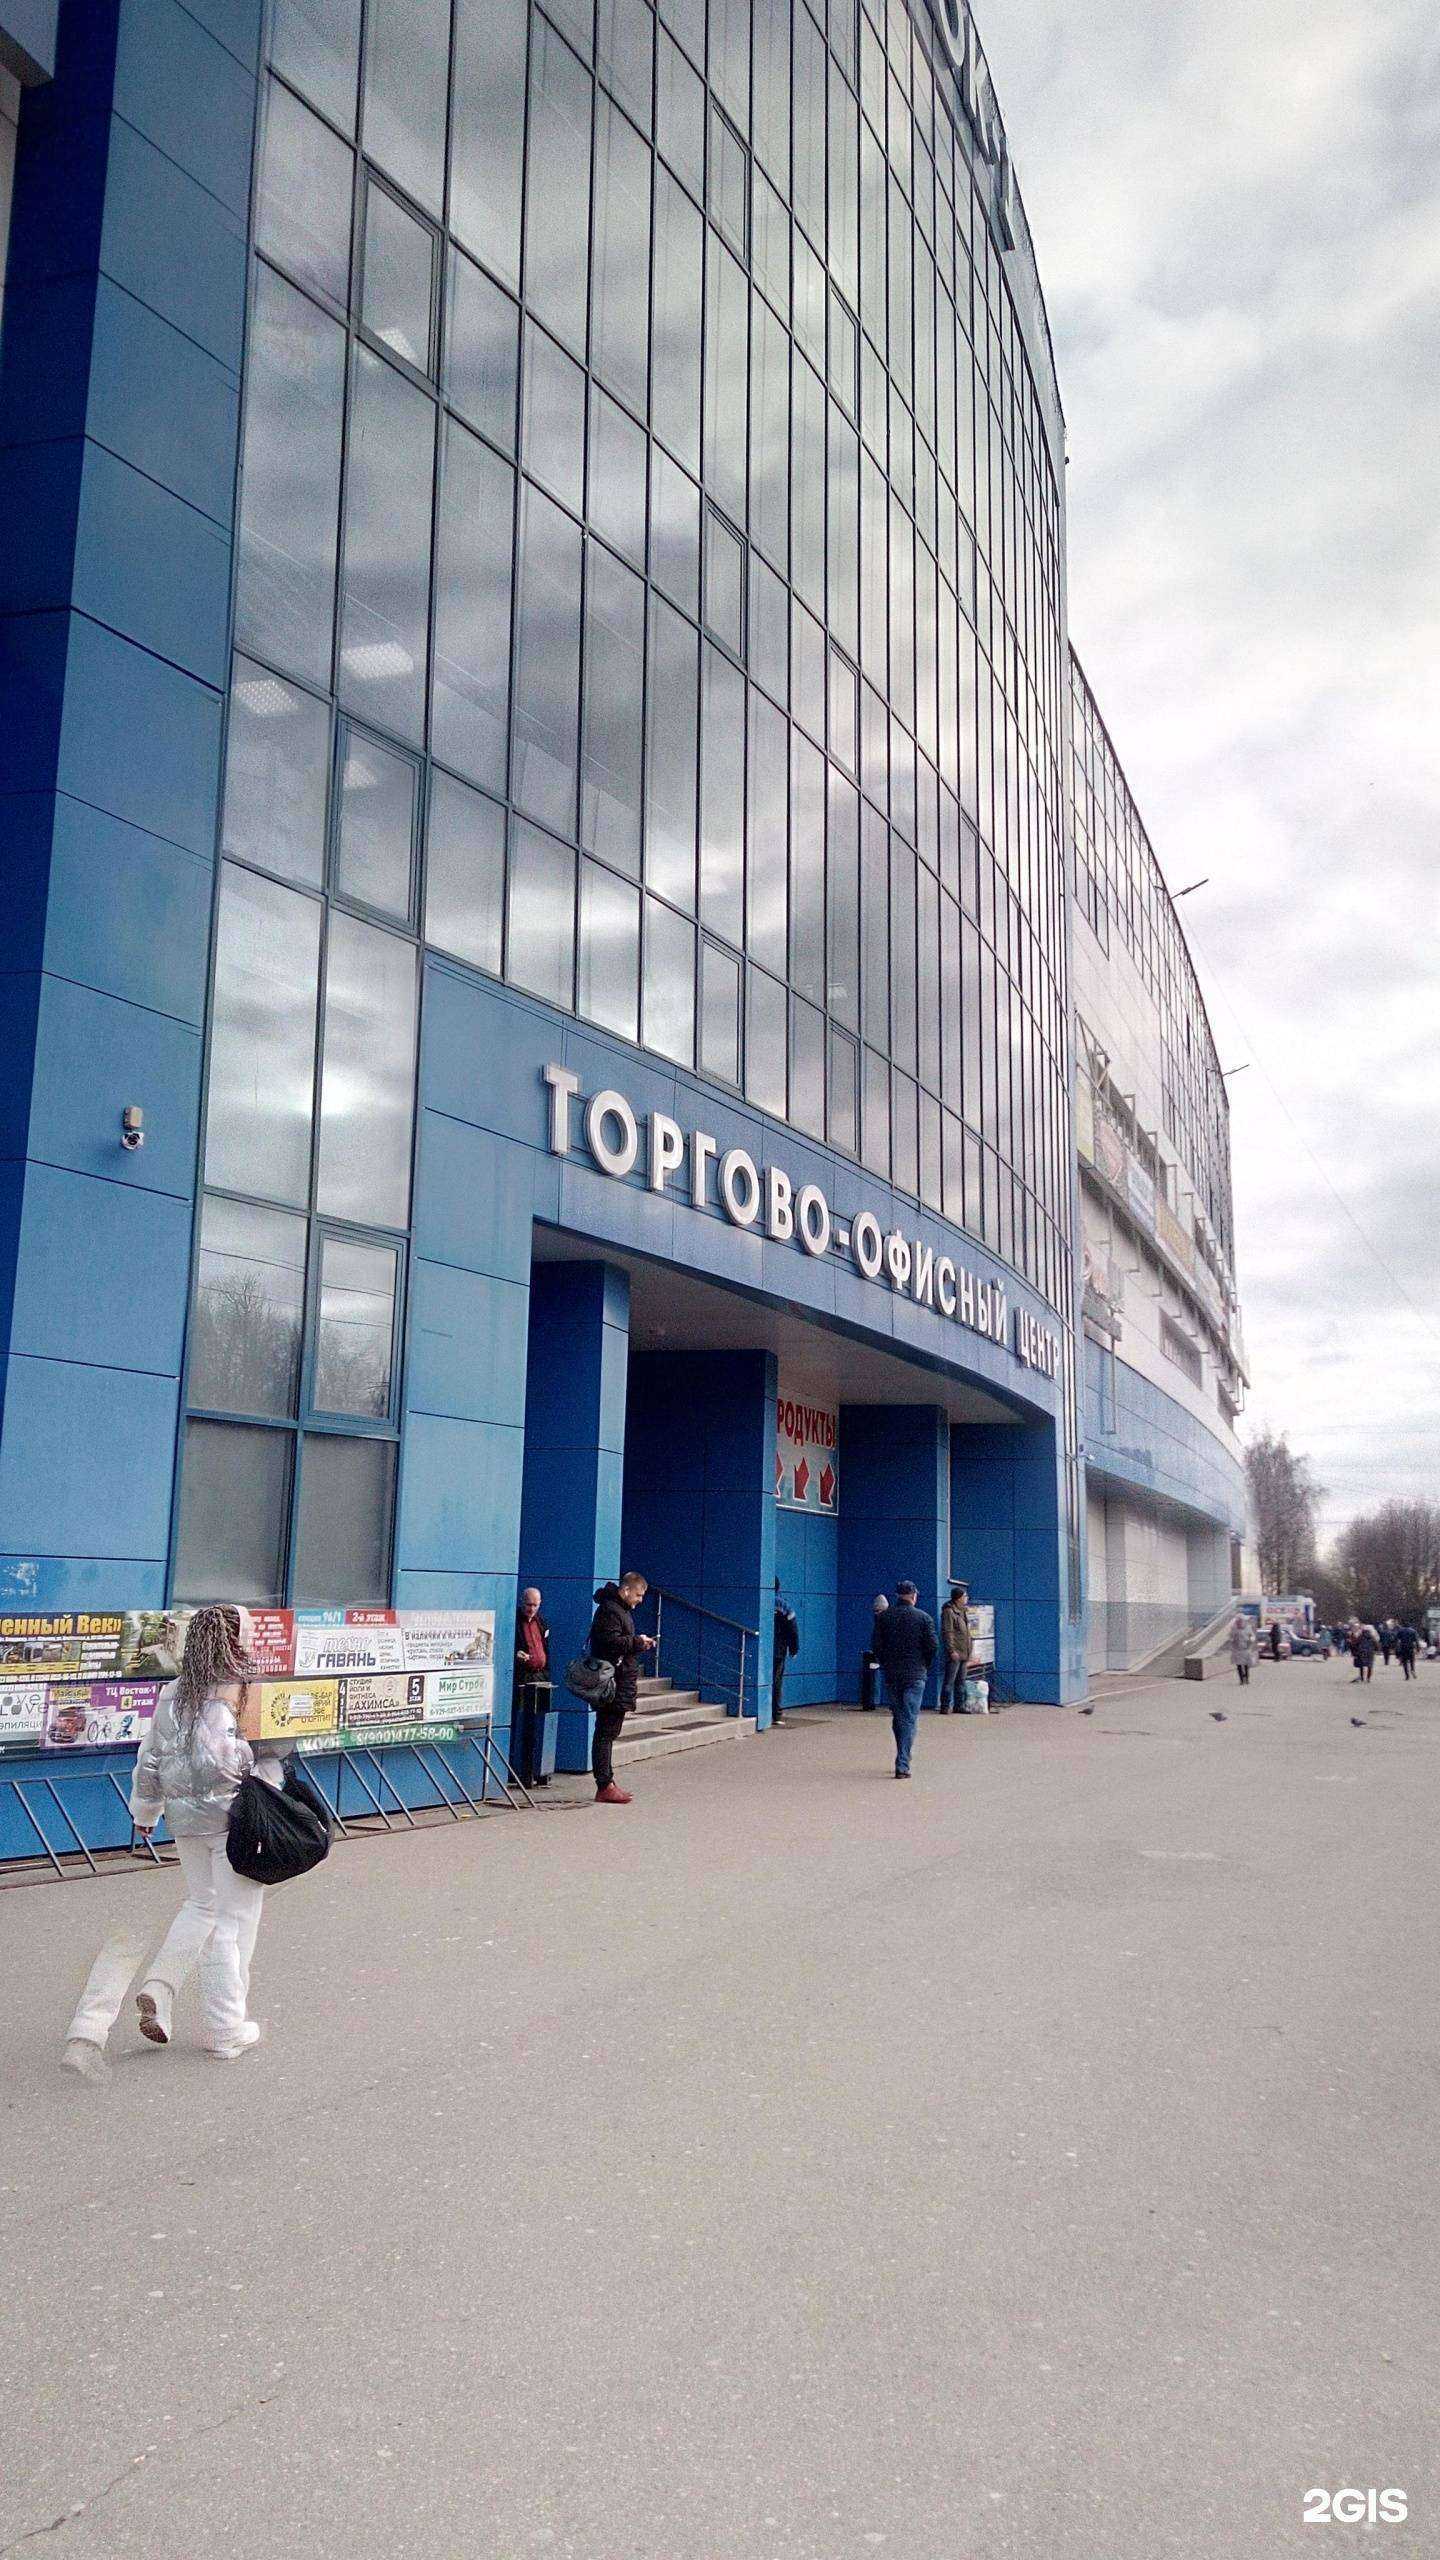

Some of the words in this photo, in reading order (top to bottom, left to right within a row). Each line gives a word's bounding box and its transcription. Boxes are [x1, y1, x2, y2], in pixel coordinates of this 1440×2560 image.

[542, 1062, 1008, 1346] ТОРГОВО-ОФИСНЫЙ
[1015, 1306, 1062, 1380] ЦЕНТР
[0, 1614, 74, 1636] енный
[317, 1652, 376, 1668] ГАВАНЬ
[105, 1686, 119, 1698] ТЦ
[120, 1684, 157, 1696] Восток-1
[411, 1678, 421, 1696] 5
[438, 1680, 457, 1694] Мир
[132, 1698, 154, 1706] этаж
